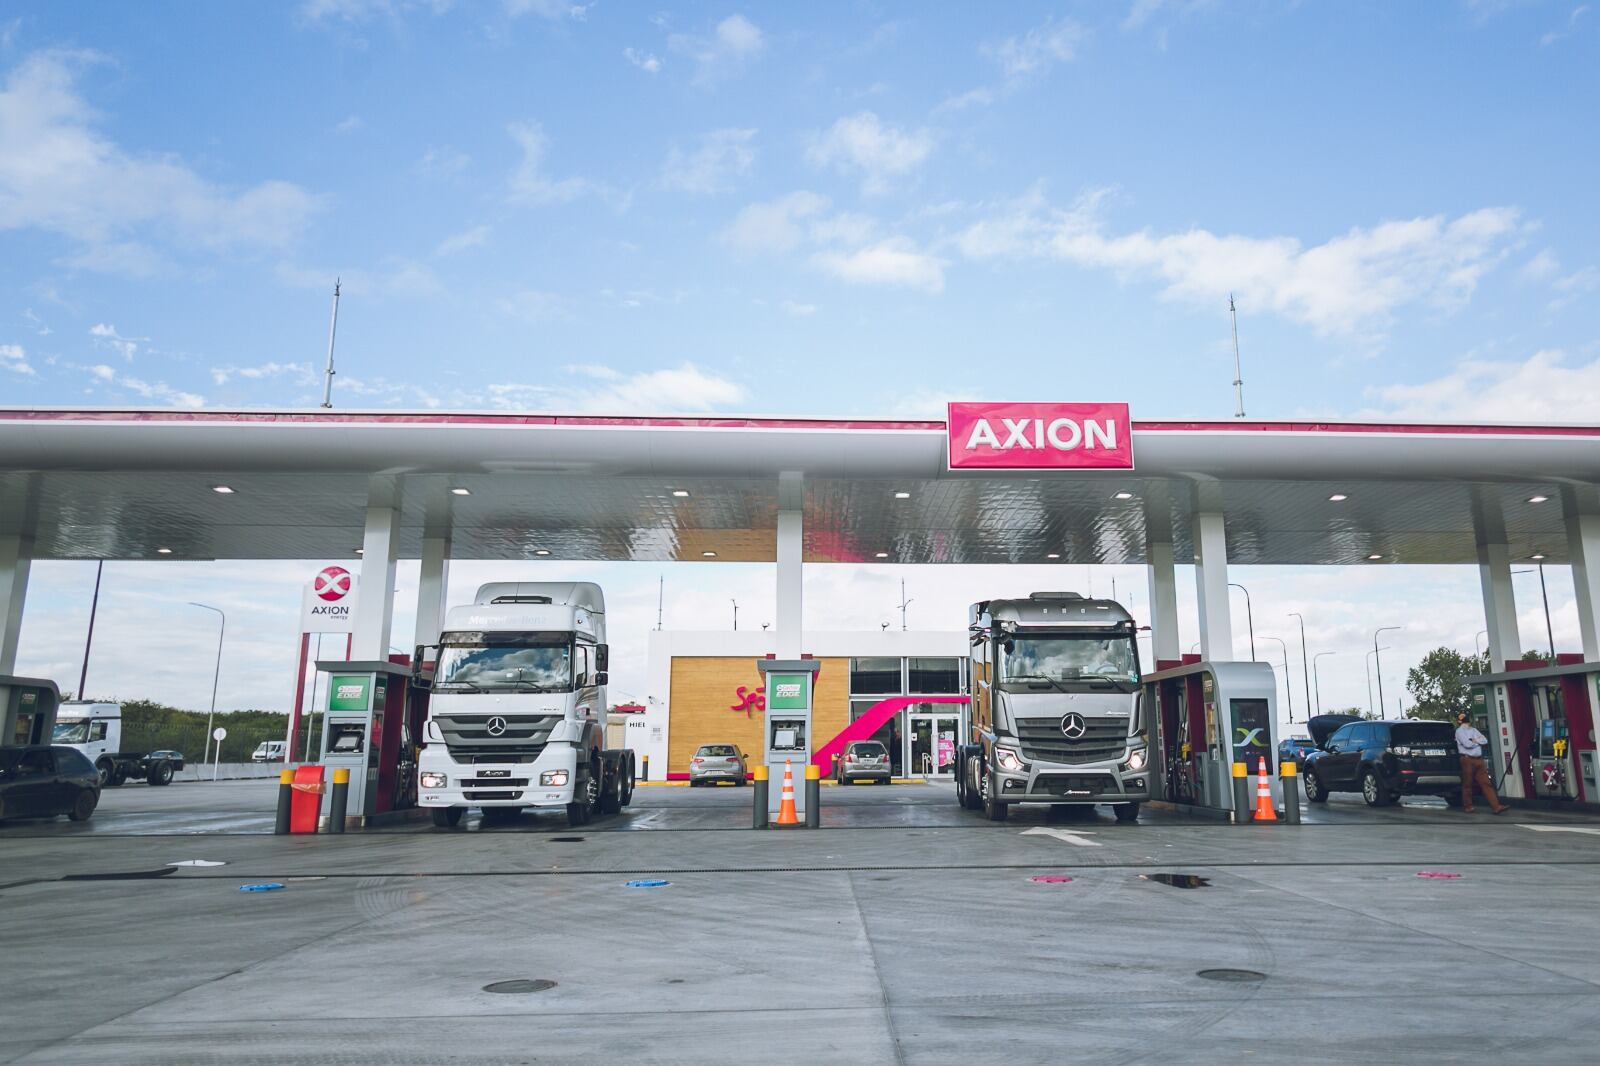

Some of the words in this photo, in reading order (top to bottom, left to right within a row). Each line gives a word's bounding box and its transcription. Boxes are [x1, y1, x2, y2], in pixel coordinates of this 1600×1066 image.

[965, 418, 1118, 450] AXION
[311, 606, 349, 614] AXION
[730, 686, 766, 719] Spo
